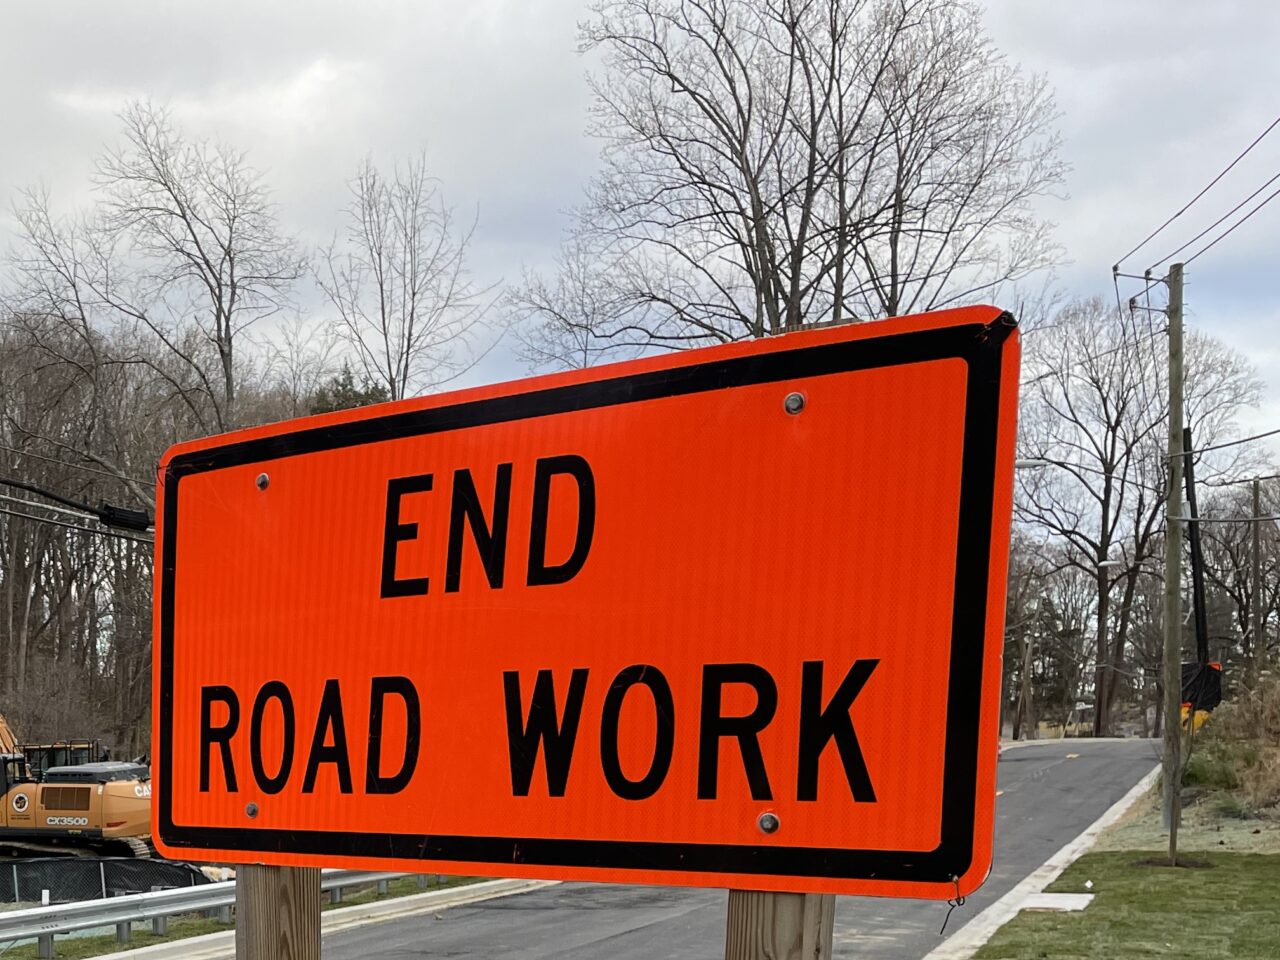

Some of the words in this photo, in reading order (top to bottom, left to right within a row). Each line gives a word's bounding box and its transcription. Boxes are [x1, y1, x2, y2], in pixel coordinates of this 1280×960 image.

[380, 454, 596, 599] END
[199, 675, 421, 796] ROAD
[502, 658, 881, 803] WORK
[46, 816, 89, 826] CX350D
